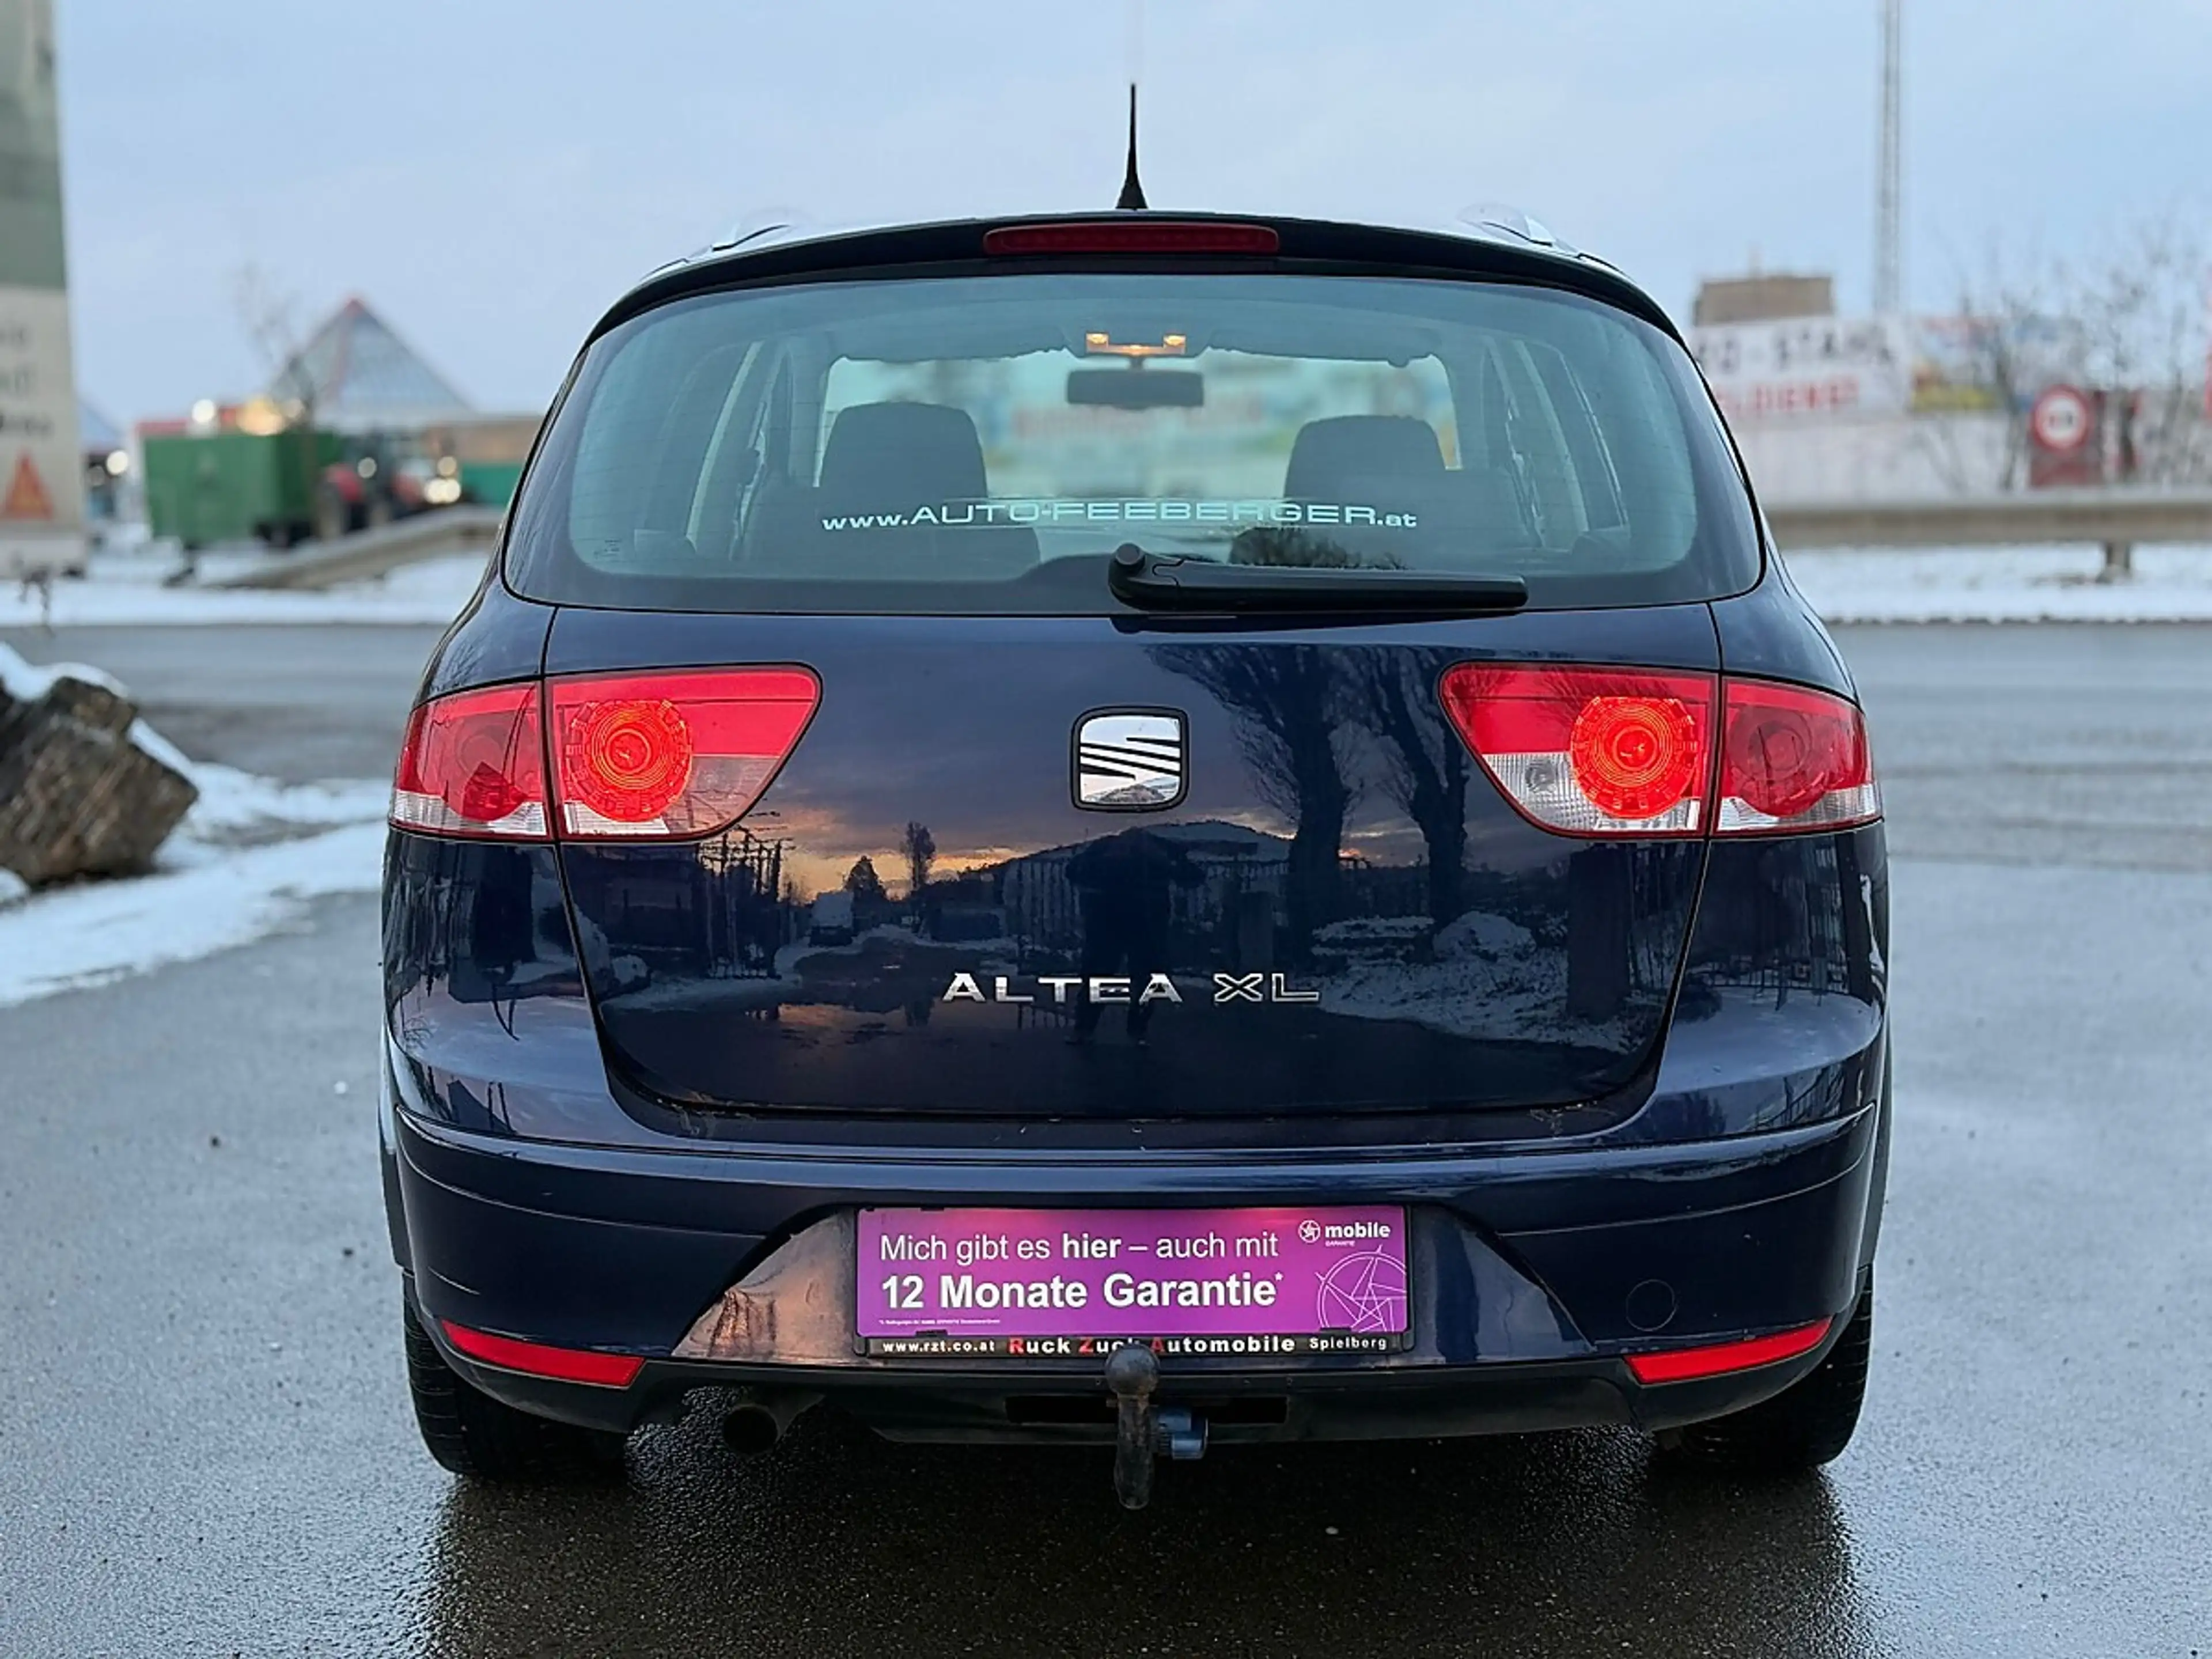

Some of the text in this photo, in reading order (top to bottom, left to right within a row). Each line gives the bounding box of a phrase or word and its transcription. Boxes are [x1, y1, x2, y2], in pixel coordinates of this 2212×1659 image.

[821, 501, 1418, 531] www.AUTO-FEEBERGER.at
[941, 972, 1320, 1003] ALTEA XL
[1324, 1222, 1391, 1238] mobile
[880, 1234, 948, 1260] Mich
[956, 1233, 1009, 1266] gibt
[1016, 1239, 1051, 1259] es
[1062, 1233, 1122, 1259] hier
[1156, 1231, 1226, 1259] auch
[1236, 1230, 1279, 1257] mit
[882, 1275, 924, 1309] 12
[940, 1274, 1088, 1309] Monate
[882, 1339, 996, 1353] www.rzt.co.at
[1009, 1336, 1071, 1354] Ruck
[1151, 1335, 1296, 1354] Automobile
